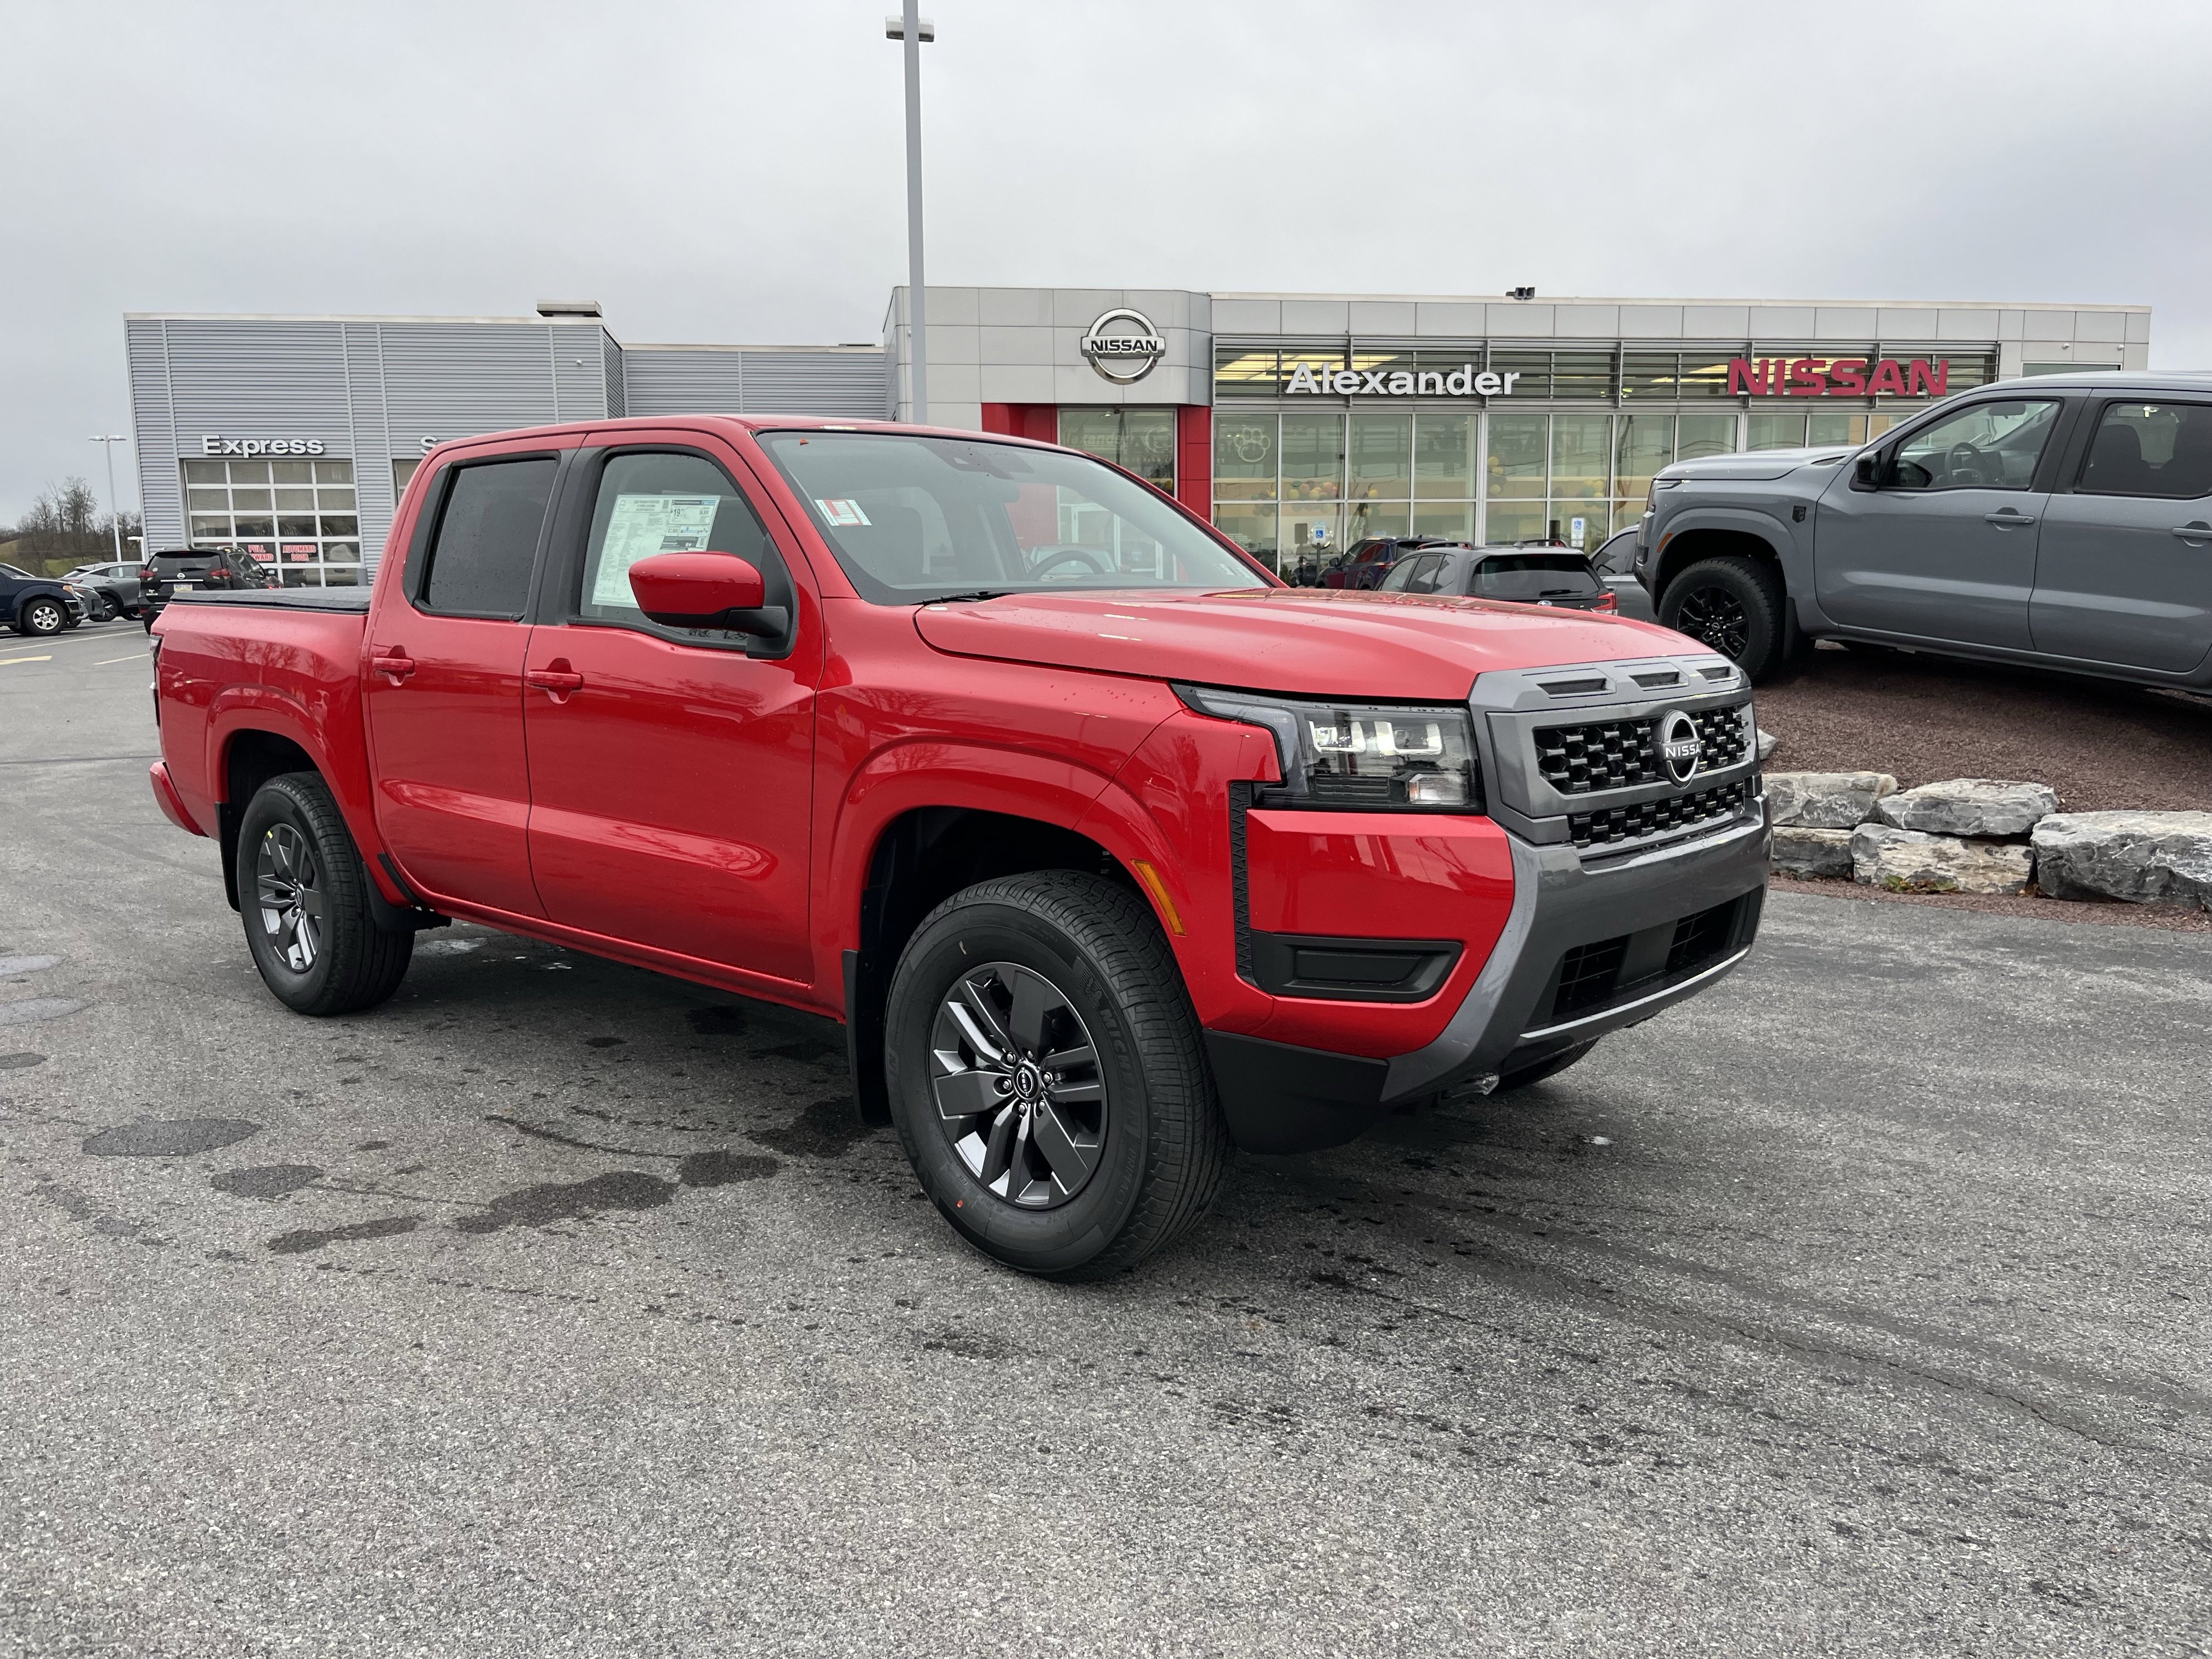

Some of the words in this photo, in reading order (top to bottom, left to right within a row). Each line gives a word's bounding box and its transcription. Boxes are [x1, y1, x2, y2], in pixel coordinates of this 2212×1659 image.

[1091, 340, 1157, 352] NISSAN
[1285, 363, 1520, 396] Alexander
[1728, 358, 1949, 396] NISSAN
[201, 435, 324, 459] Express
[420, 436, 438, 455] S
[248, 545, 266, 553] PULL
[283, 545, 317, 553] AUTOMATIC
[291, 553, 309, 561] DOOR
[1665, 743, 1701, 758] NISSA
